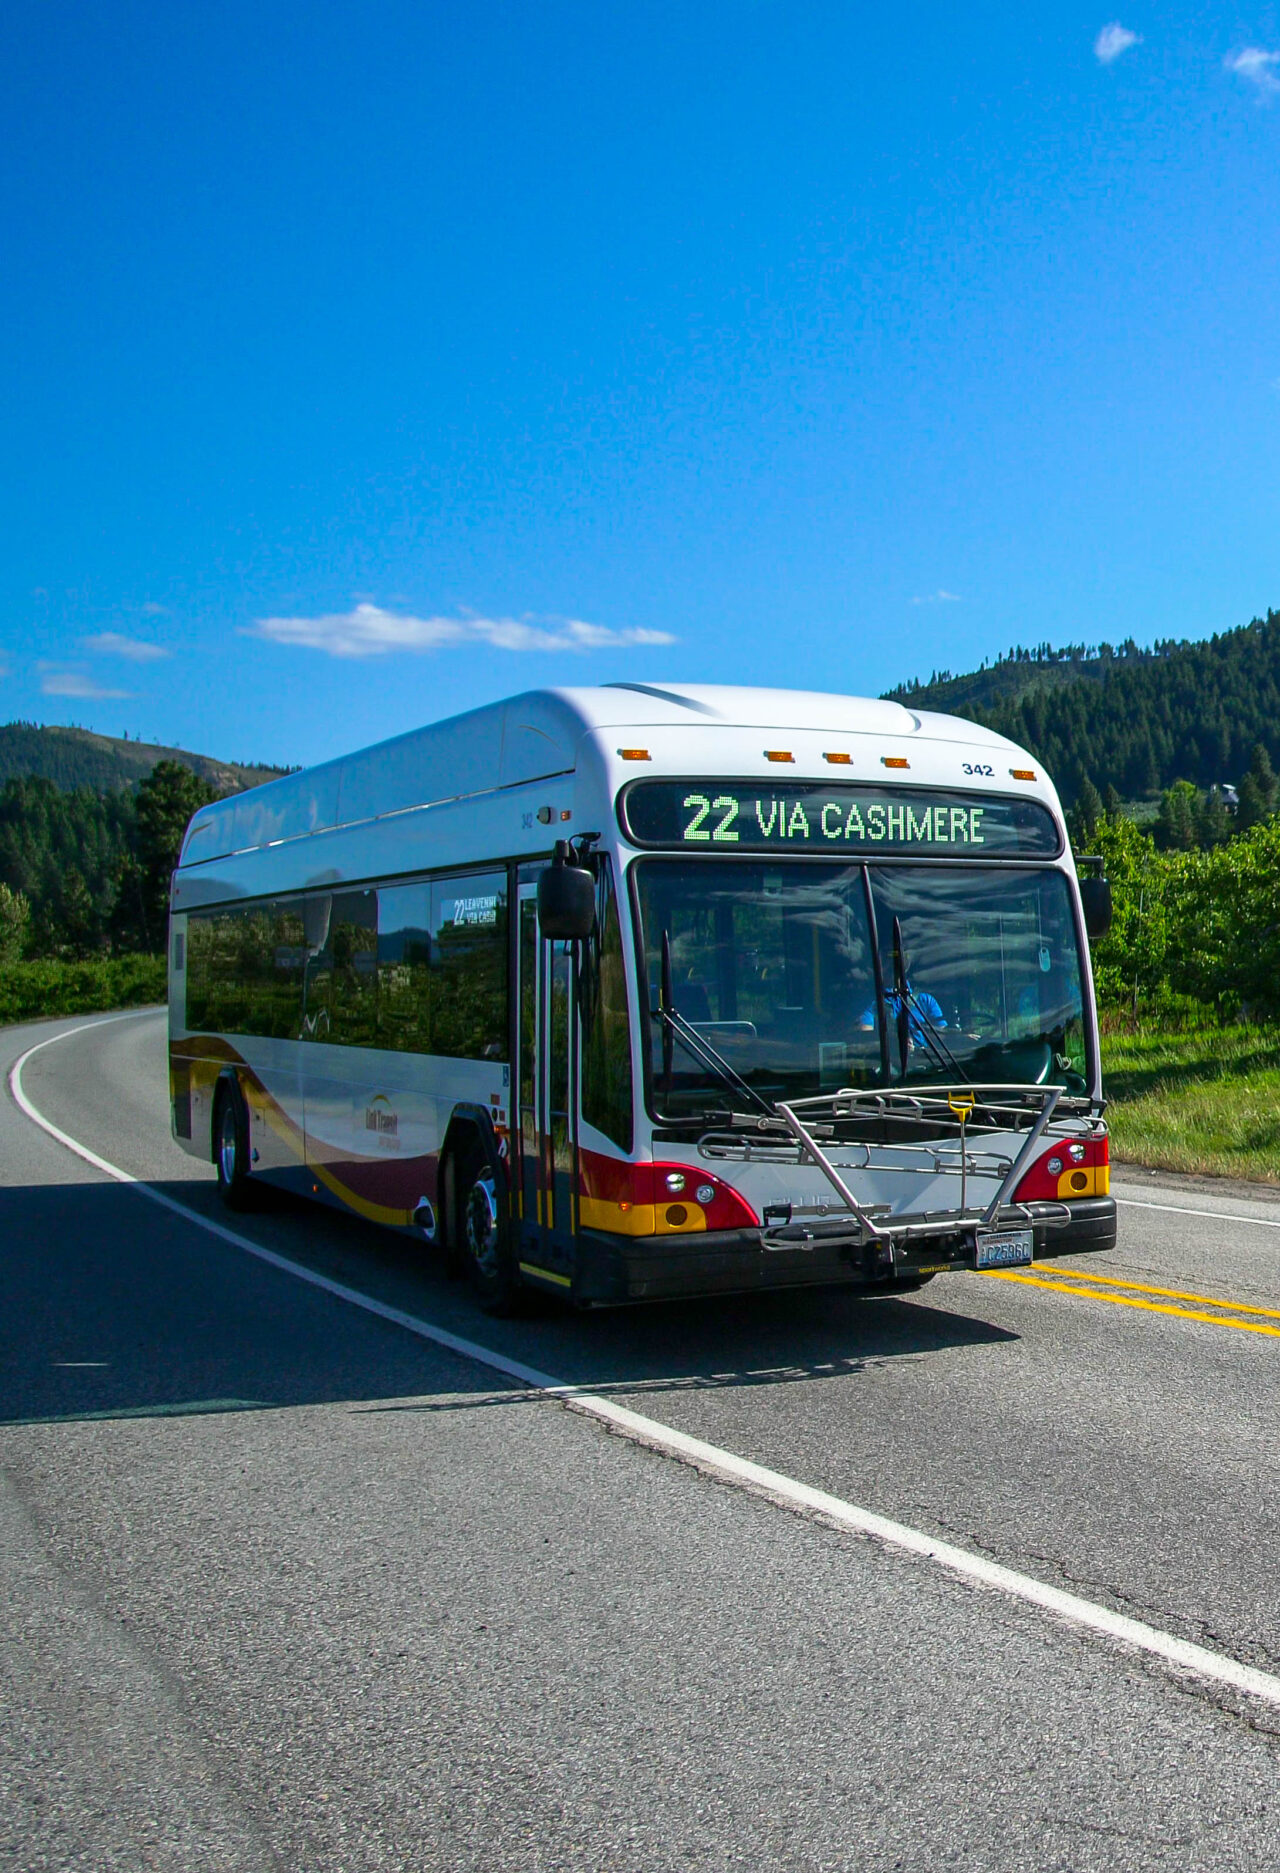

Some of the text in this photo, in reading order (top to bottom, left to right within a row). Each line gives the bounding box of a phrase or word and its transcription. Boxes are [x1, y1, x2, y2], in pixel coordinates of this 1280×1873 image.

[961, 762, 995, 777] 342
[683, 795, 985, 843] 22 VIA CASHMERE
[453, 899, 465, 926] 22
